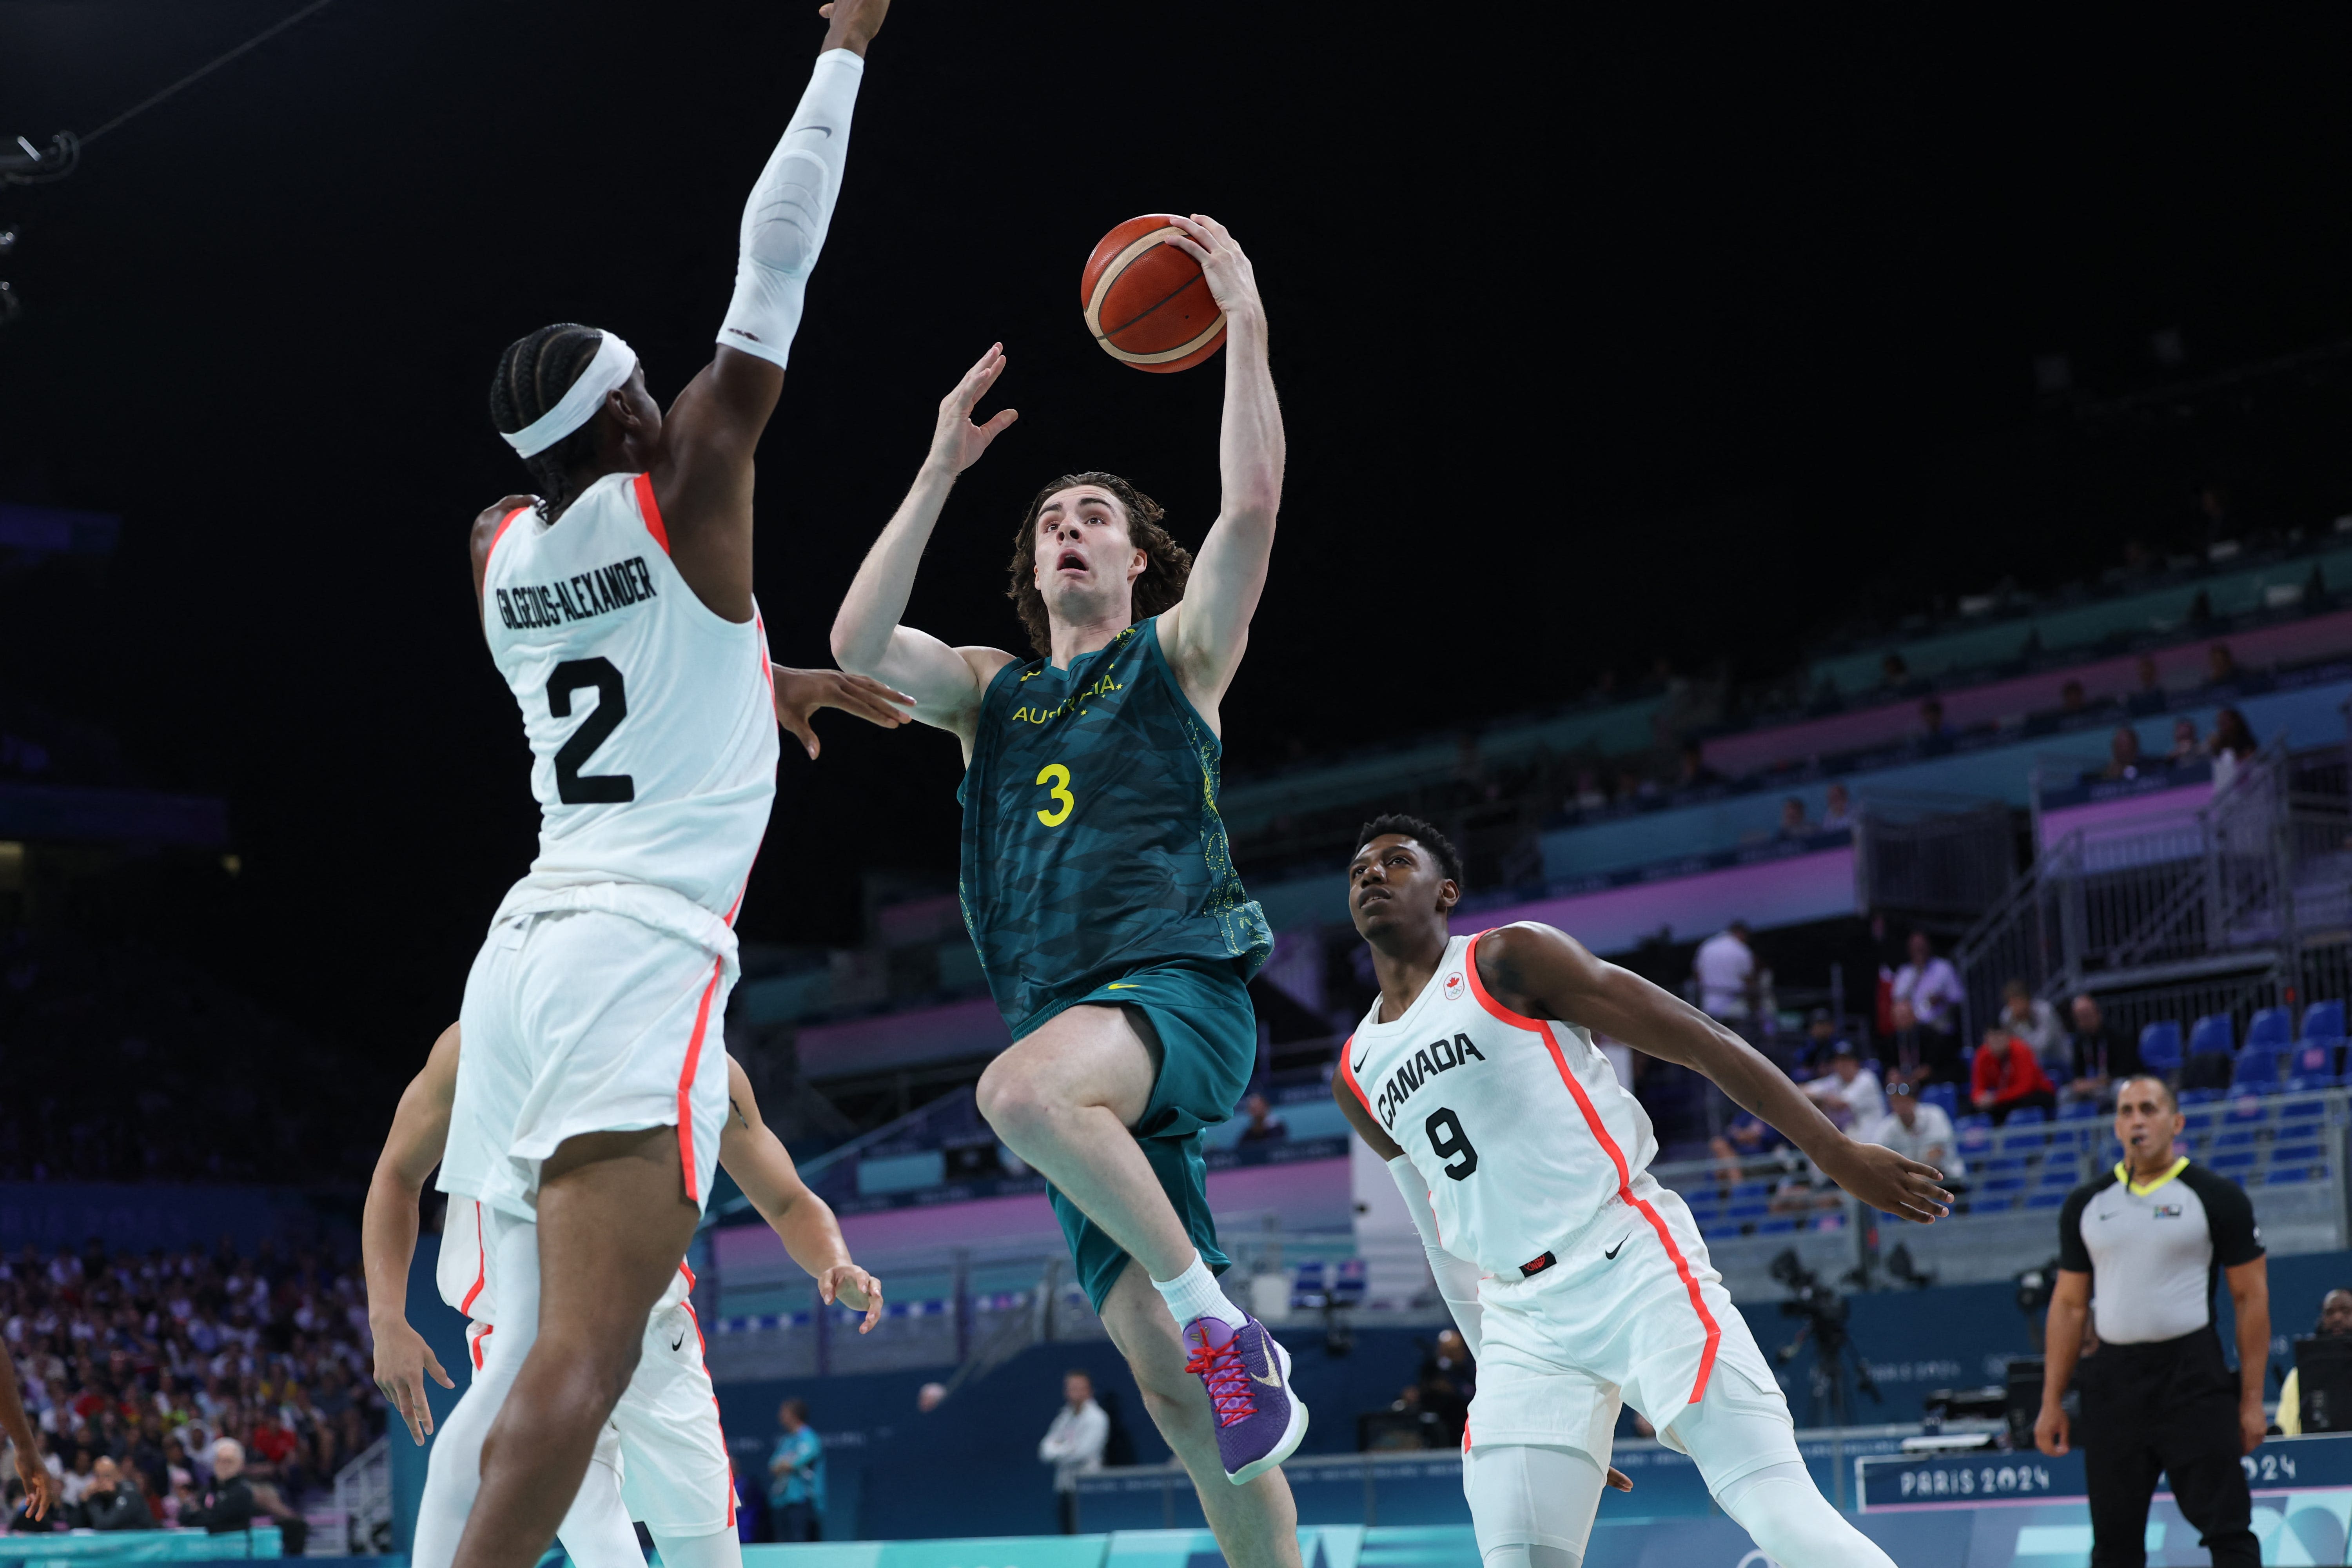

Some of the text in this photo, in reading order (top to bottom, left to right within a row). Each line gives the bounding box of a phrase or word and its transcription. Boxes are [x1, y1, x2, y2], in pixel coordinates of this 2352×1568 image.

[497, 556, 657, 629] GILGEOUS-ALEXANDER
[546, 656, 635, 804] 2
[1012, 675, 1115, 724] AURIA
[1036, 764, 1074, 827] 3
[1377, 1033, 1486, 1131] CANADA
[1425, 1107, 1478, 1181] 9
[1980, 1465, 2050, 1493] 2024
